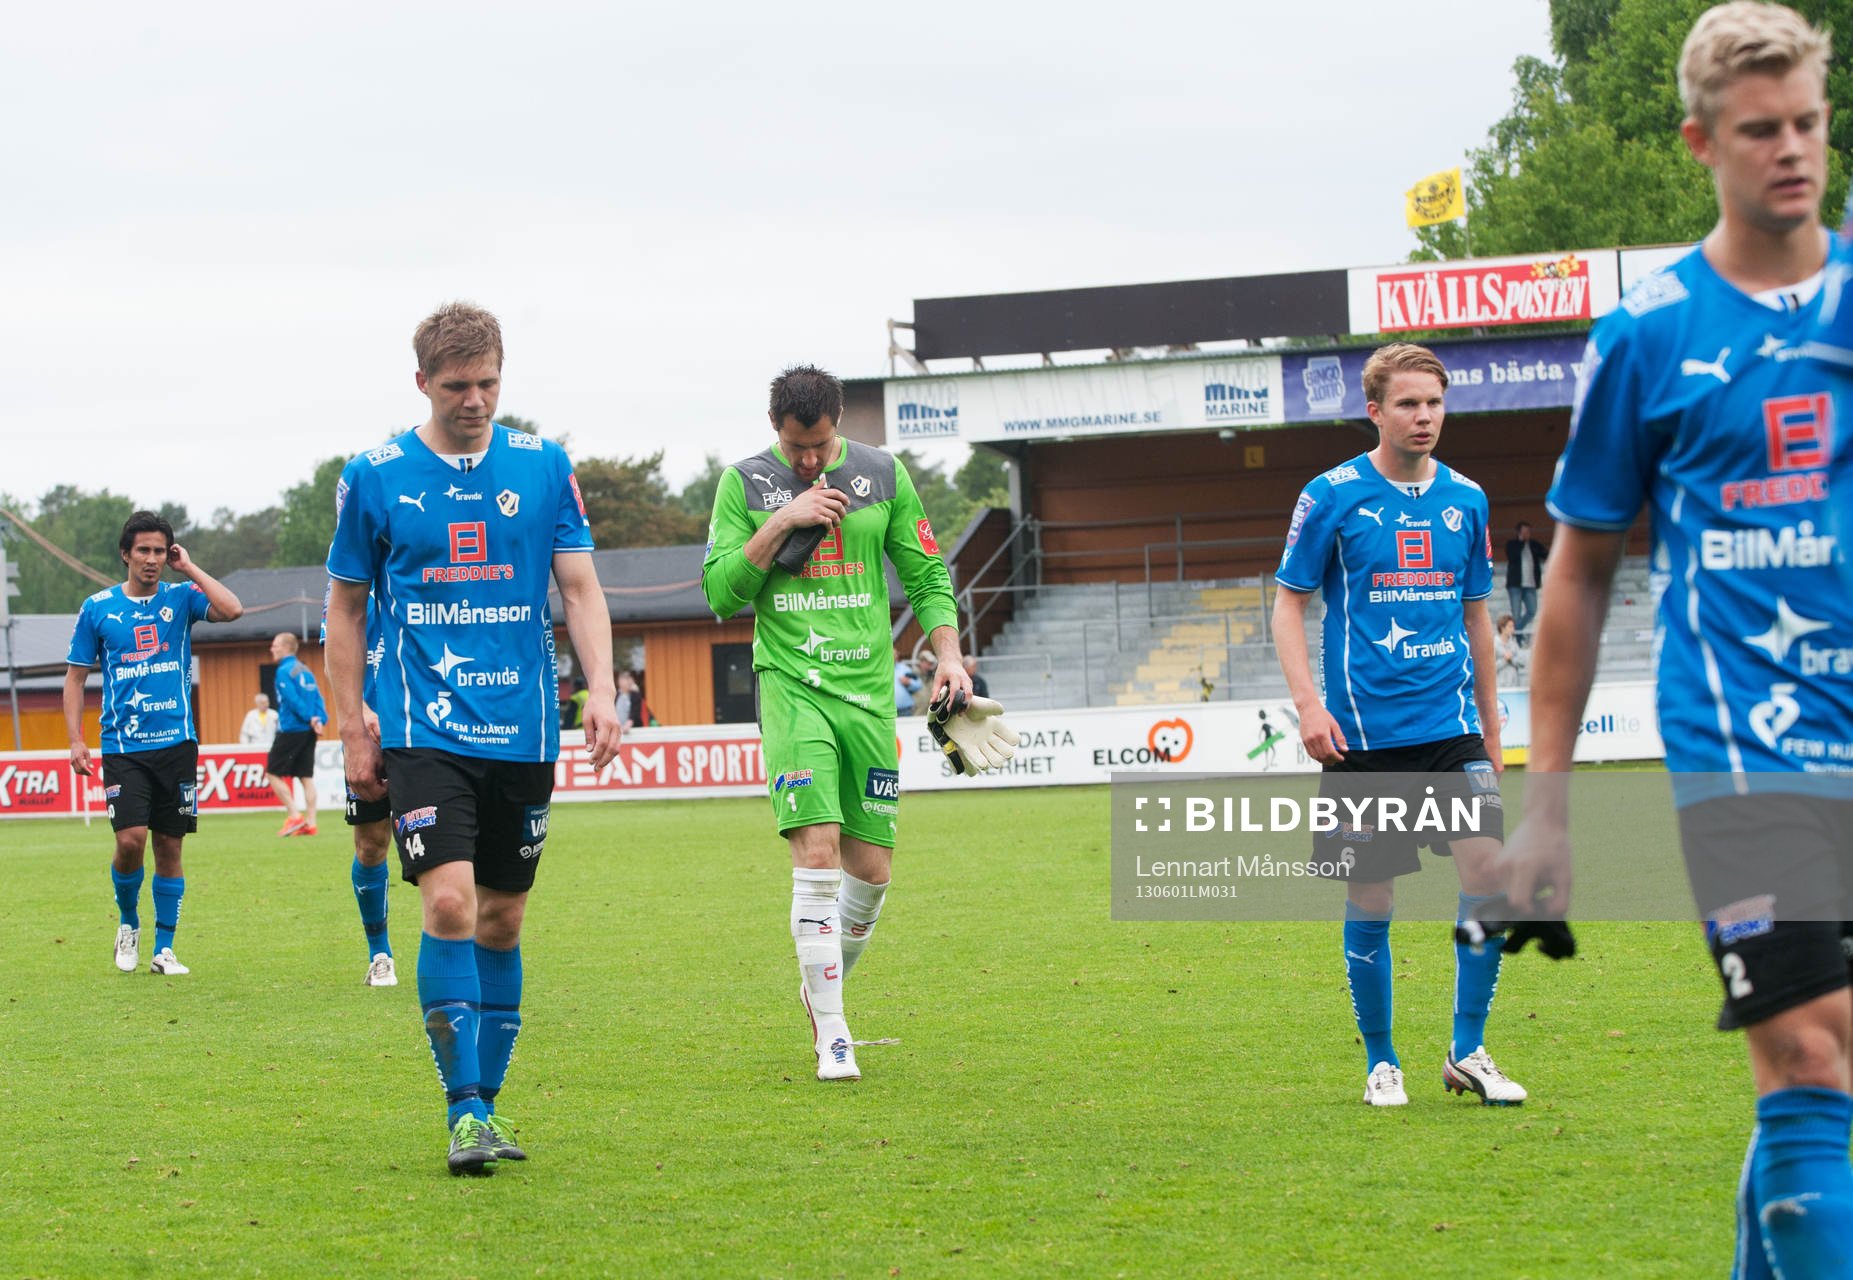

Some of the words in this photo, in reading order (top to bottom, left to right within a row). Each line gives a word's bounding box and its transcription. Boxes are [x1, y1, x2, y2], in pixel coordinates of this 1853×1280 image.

[1378, 271, 1588, 329] KVÄLLSPOSTEN
[1489, 360, 1564, 384] bästa
[1205, 401, 1270, 416] MARINE
[898, 421, 959, 434] MARINE
[1004, 411, 1162, 432] WWW.MMGMARINE.SE
[456, 491, 483, 501] bravida
[422, 564, 514, 583] FREDDIE'S
[796, 562, 864, 579] REDDIE'S
[1372, 572, 1455, 587] FREDDIE'S
[1369, 588, 1456, 603] BilMånsson
[407, 600, 531, 625] BilMånsson
[820, 646, 871, 662] bravida
[1403, 637, 1455, 659] bravida
[457, 668, 519, 686] bravida
[142, 698, 177, 712] bravida
[446, 721, 468, 733] FEM
[472, 723, 519, 735] HJÄRTAN
[458, 734, 510, 745] FASTIGHETER
[1018, 731, 1075, 749] DATA
[1094, 747, 1171, 765] ELCOM
[551, 745, 666, 787] TEAM
[785, 769, 812, 781] INTER
[786, 778, 812, 789] SPORT
[786, 793, 797, 812] 1
[408, 815, 436, 831] SPORT
[405, 833, 425, 860] 14
[1341, 847, 1355, 869] 6
[1721, 952, 1753, 999] 2
